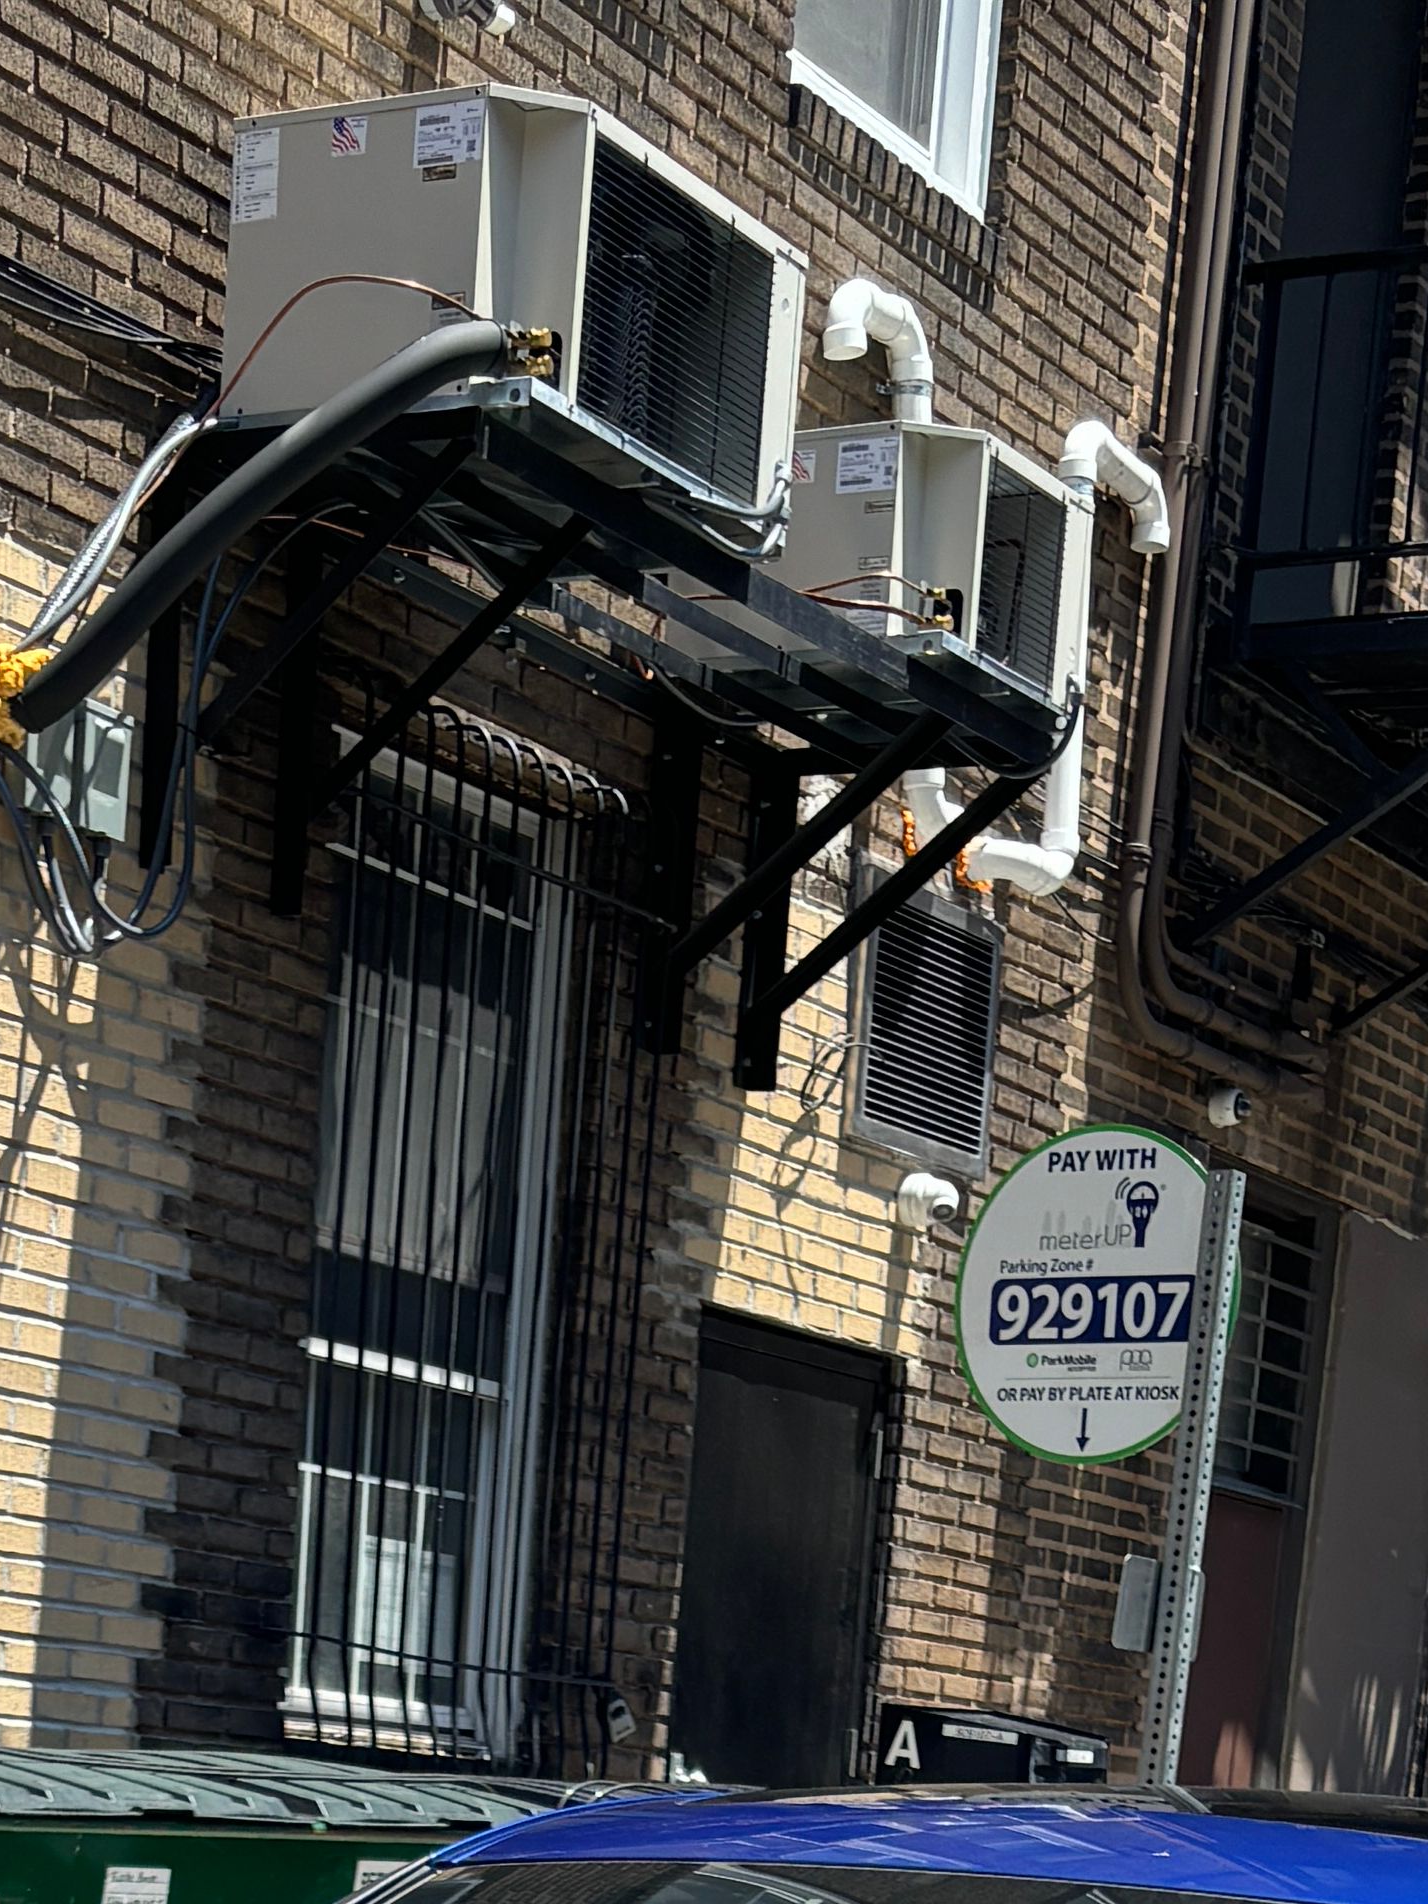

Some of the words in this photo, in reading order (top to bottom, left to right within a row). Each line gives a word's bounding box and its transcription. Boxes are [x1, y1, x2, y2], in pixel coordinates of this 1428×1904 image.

[1047, 1149, 1092, 1173] PAY
[1096, 1147, 1158, 1172] WITH
[1039, 1222, 1133, 1251] meterUP
[999, 1257, 1048, 1275] Parking
[1050, 1257, 1084, 1273] Zone
[996, 1281, 1191, 1341] 929107
[997, 1386, 1018, 1402] OR
[1019, 1386, 1046, 1402] PAY
[1047, 1386, 1067, 1401] BY
[1068, 1385, 1113, 1401] PLATE
[1114, 1385, 1134, 1401] AT
[1135, 1385, 1179, 1400] KIOSK
[884, 1719, 921, 1770] A
